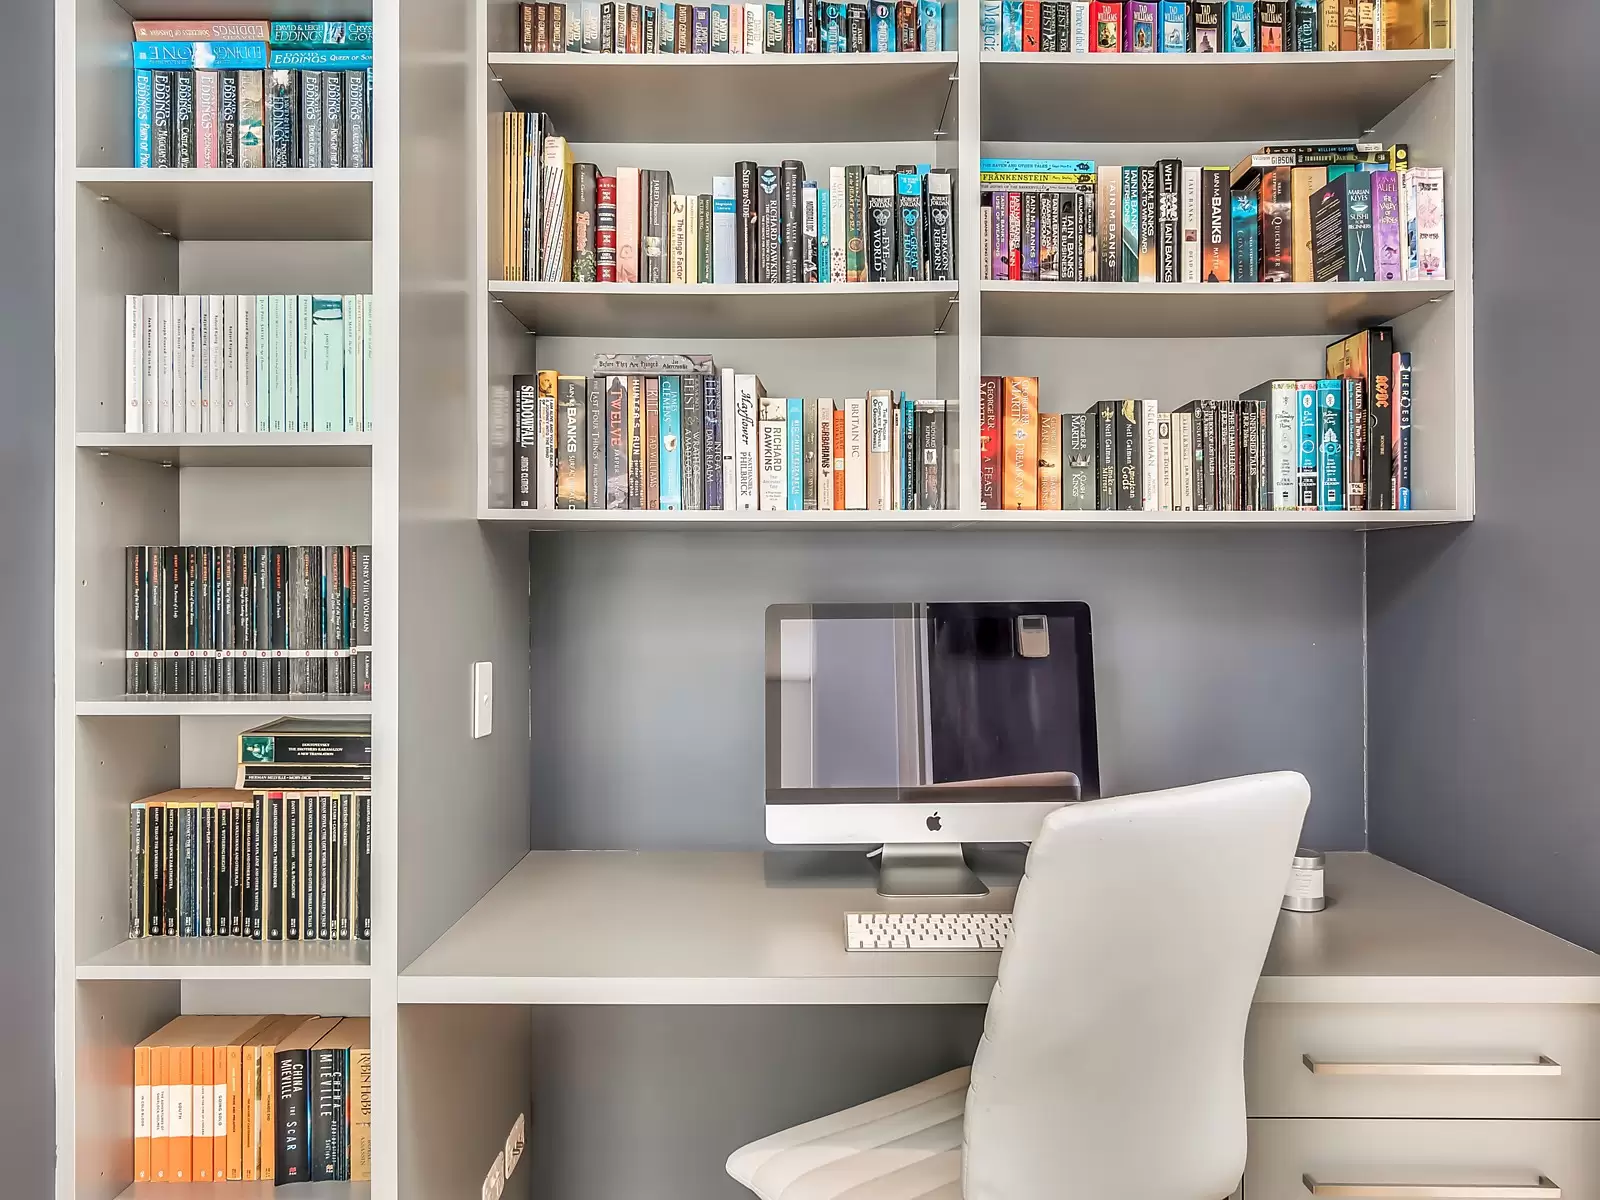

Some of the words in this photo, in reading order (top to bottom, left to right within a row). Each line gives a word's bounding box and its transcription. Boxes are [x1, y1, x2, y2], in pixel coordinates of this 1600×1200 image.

[1098, 13, 1117, 21] WILLIAMS
[1134, 12, 1153, 21] WILLIAMS
[1139, 5, 1148, 13] TAD
[1165, 13, 1183, 21] WILLIAMS
[1196, 13, 1217, 24] WILLIAMS
[1201, 5, 1211, 14] TAD
[1261, 12, 1282, 24] WILLIAMS
[1266, 4, 1276, 13] TAD
[275, 31, 323, 41] EDDINGS
[137, 76, 148, 120] EDDINGS
[155, 75, 168, 126] EDDINGS
[179, 78, 189, 120] EDDINGS
[223, 78, 233, 120] EDDINGS
[139, 123, 149, 138] PAWN
[272, 96, 284, 142] EDDINGS
[158, 130, 167, 163] MAGICIAN'S
[181, 127, 189, 147] CASTLE
[743, 190, 749, 198] BY
[1142, 195, 1147, 206] TO
[1148, 190, 1154, 200] M.
[1078, 225, 1083, 233] ON
[1109, 210, 1116, 221] M.
[674, 234, 684, 256] Hinge
[1272, 217, 1282, 266] QUICKSILVER
[647, 390, 658, 416] RITE
[663, 381, 671, 422] CLEMENS
[684, 378, 694, 412] FEIST
[706, 380, 716, 415] FEIST
[1012, 380, 1020, 426] MARTIN
[1376, 375, 1389, 408] AC/DC
[521, 385, 534, 448] SHADOWFALL
[567, 407, 576, 452] BANKS
[737, 389, 754, 445] Mayflower
[852, 404, 860, 441] BRITAIN
[520, 456, 528, 472] JAMES
[852, 445, 860, 457] BC
[520, 473, 528, 494] CLEMENS
[1016, 443, 1024, 497] DREAMSONGS
[281, 1059, 292, 1099] MIÉVILLE
[293, 1064, 303, 1092] CHINA
[357, 1053, 371, 1084] ROBIN
[320, 1054, 332, 1116] MIÉVILLE
[333, 1072, 342, 1108] CHINA
[361, 1086, 371, 1115] HOBB
[286, 1121, 297, 1151] SCAR
